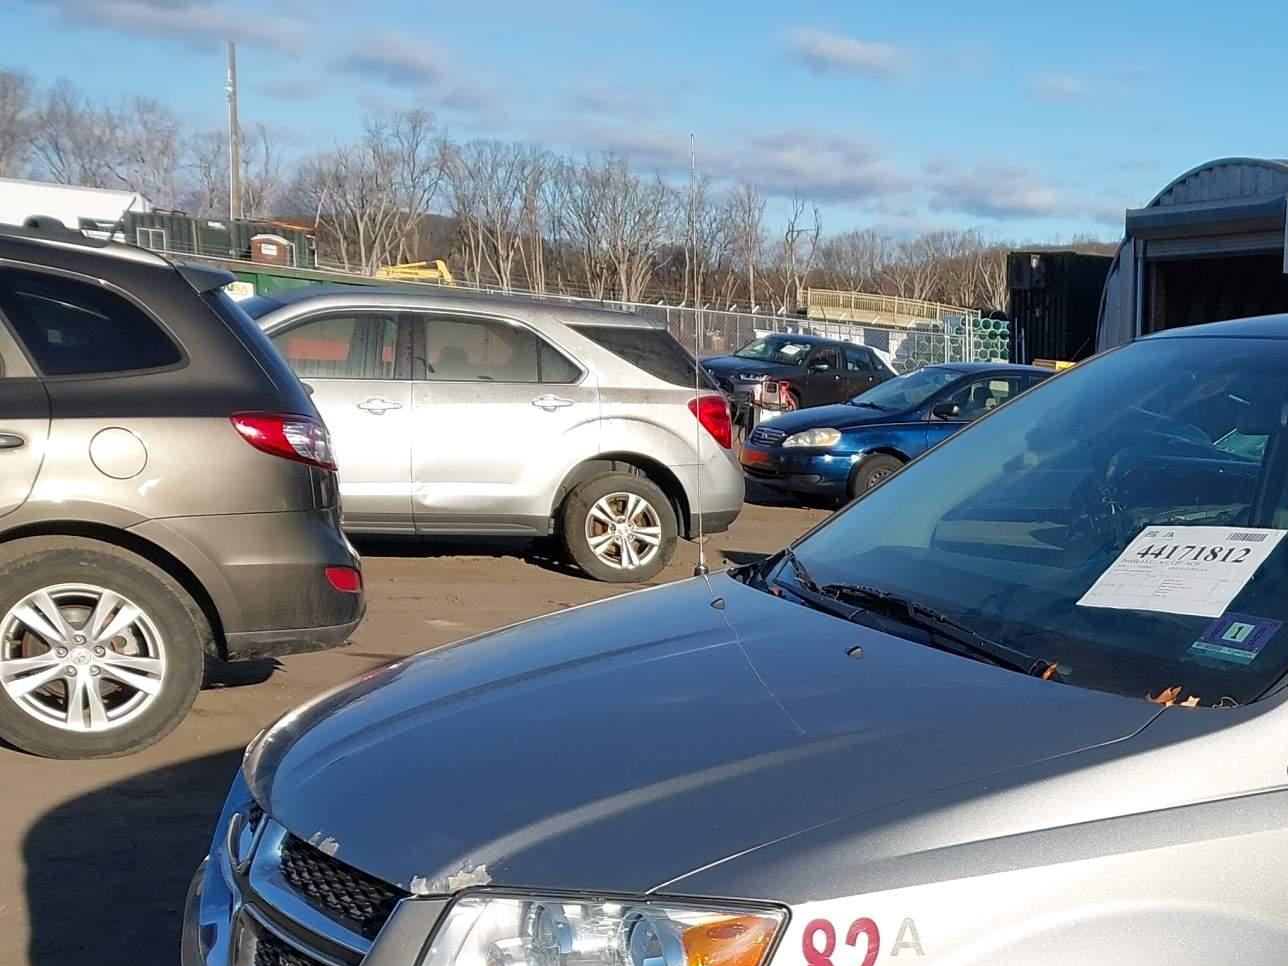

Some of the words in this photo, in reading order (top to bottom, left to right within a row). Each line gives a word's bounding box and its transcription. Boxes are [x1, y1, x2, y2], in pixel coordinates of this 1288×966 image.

[1137, 543, 1252, 563] 44171812
[1230, 625, 1244, 639] 1
[890, 917, 925, 956] A
